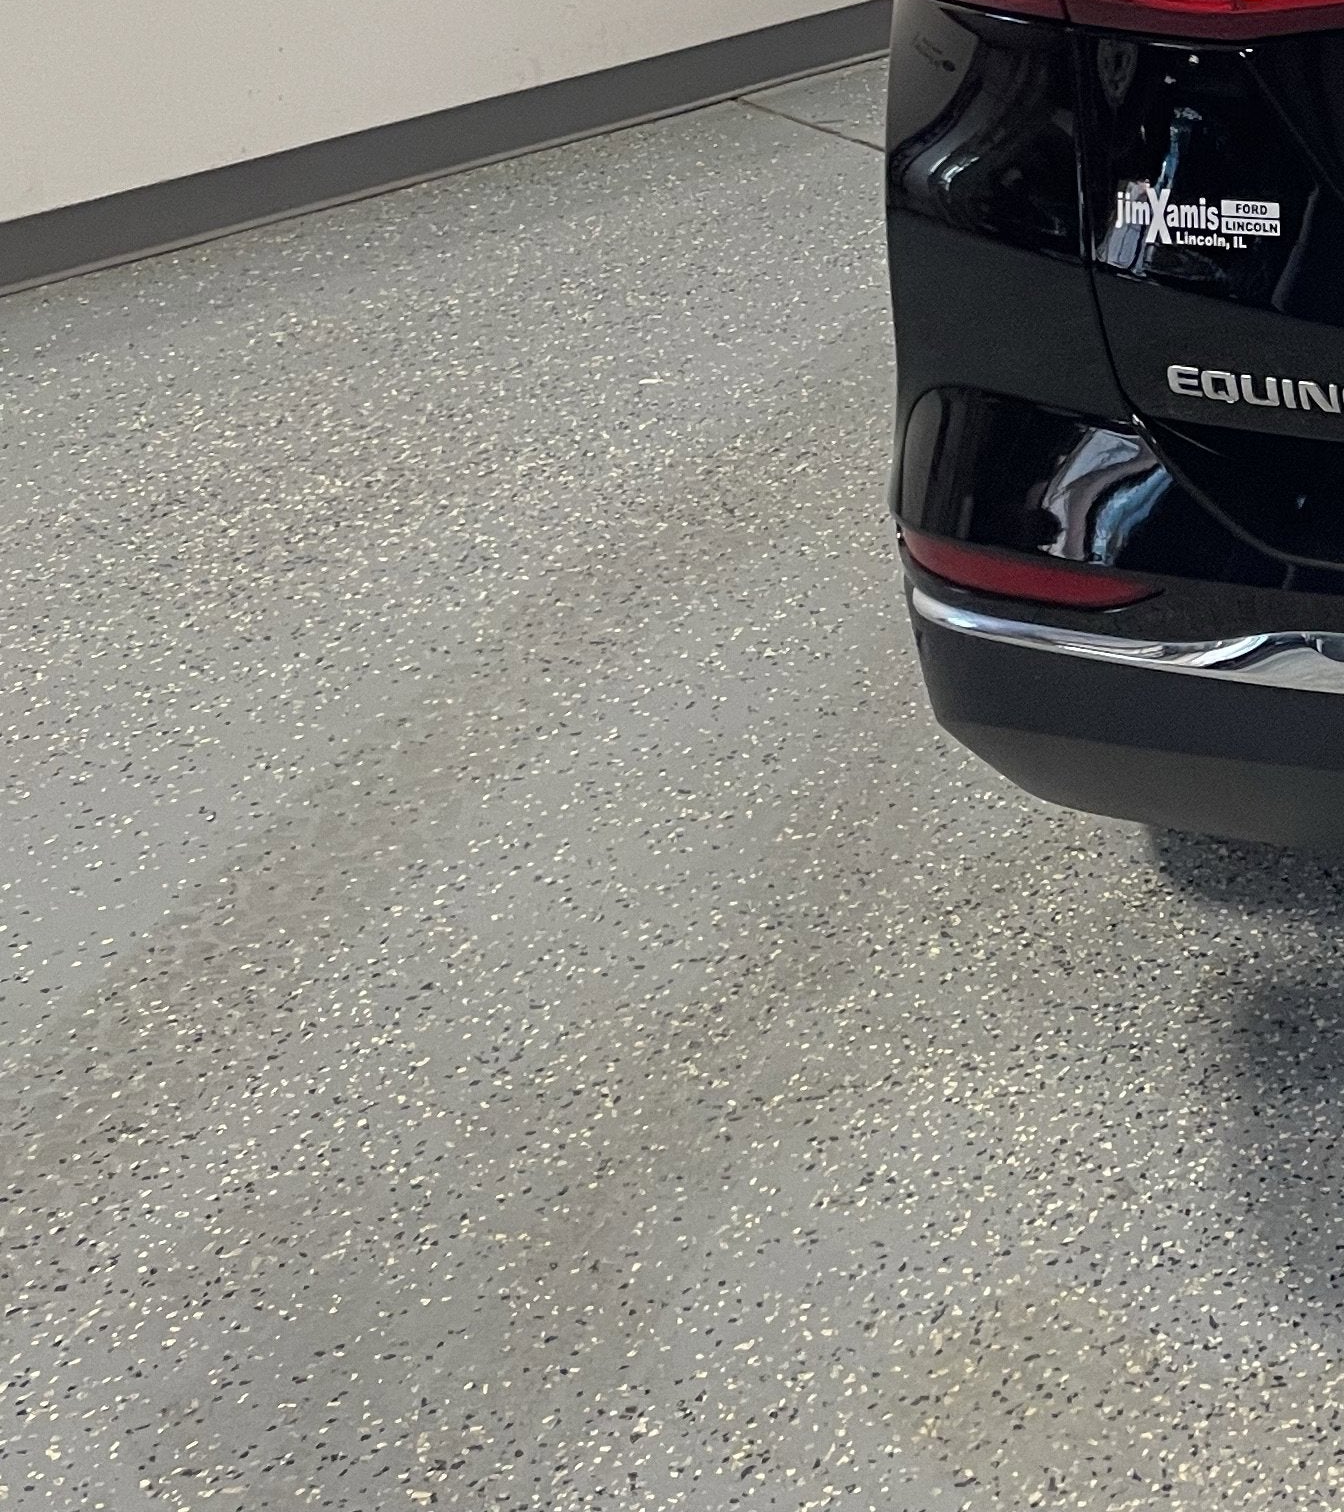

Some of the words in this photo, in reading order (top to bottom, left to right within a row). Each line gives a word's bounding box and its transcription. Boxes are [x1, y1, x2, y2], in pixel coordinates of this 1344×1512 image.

[1234, 202, 1268, 216] FORD
[1224, 220, 1279, 234] LINCOLN
[1175, 230, 1229, 250] Lincoln,
[1233, 236, 1247, 249] IL
